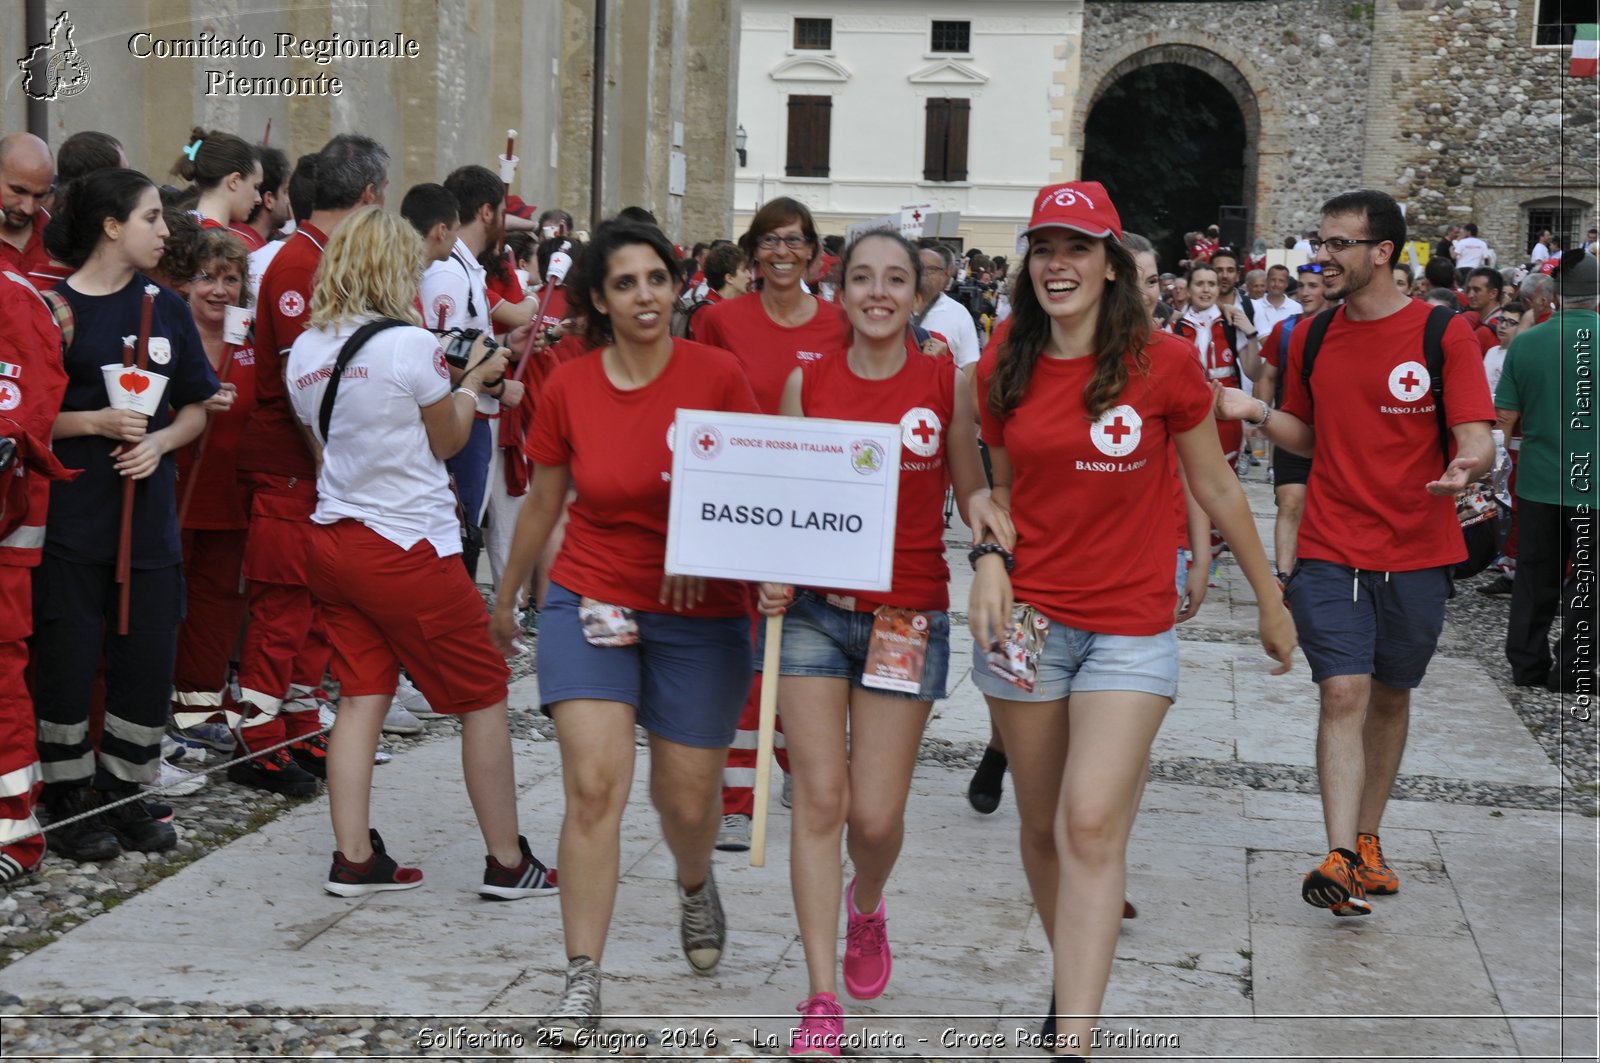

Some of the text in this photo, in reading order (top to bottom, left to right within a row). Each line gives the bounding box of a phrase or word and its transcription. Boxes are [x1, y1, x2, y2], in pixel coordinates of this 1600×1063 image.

[1380, 405, 1411, 415] BASSO
[729, 436, 844, 455] CROCE ROSSA ITALIANA
[1075, 460, 1116, 472] BASSO
[701, 502, 863, 533] BASSO LARIO
